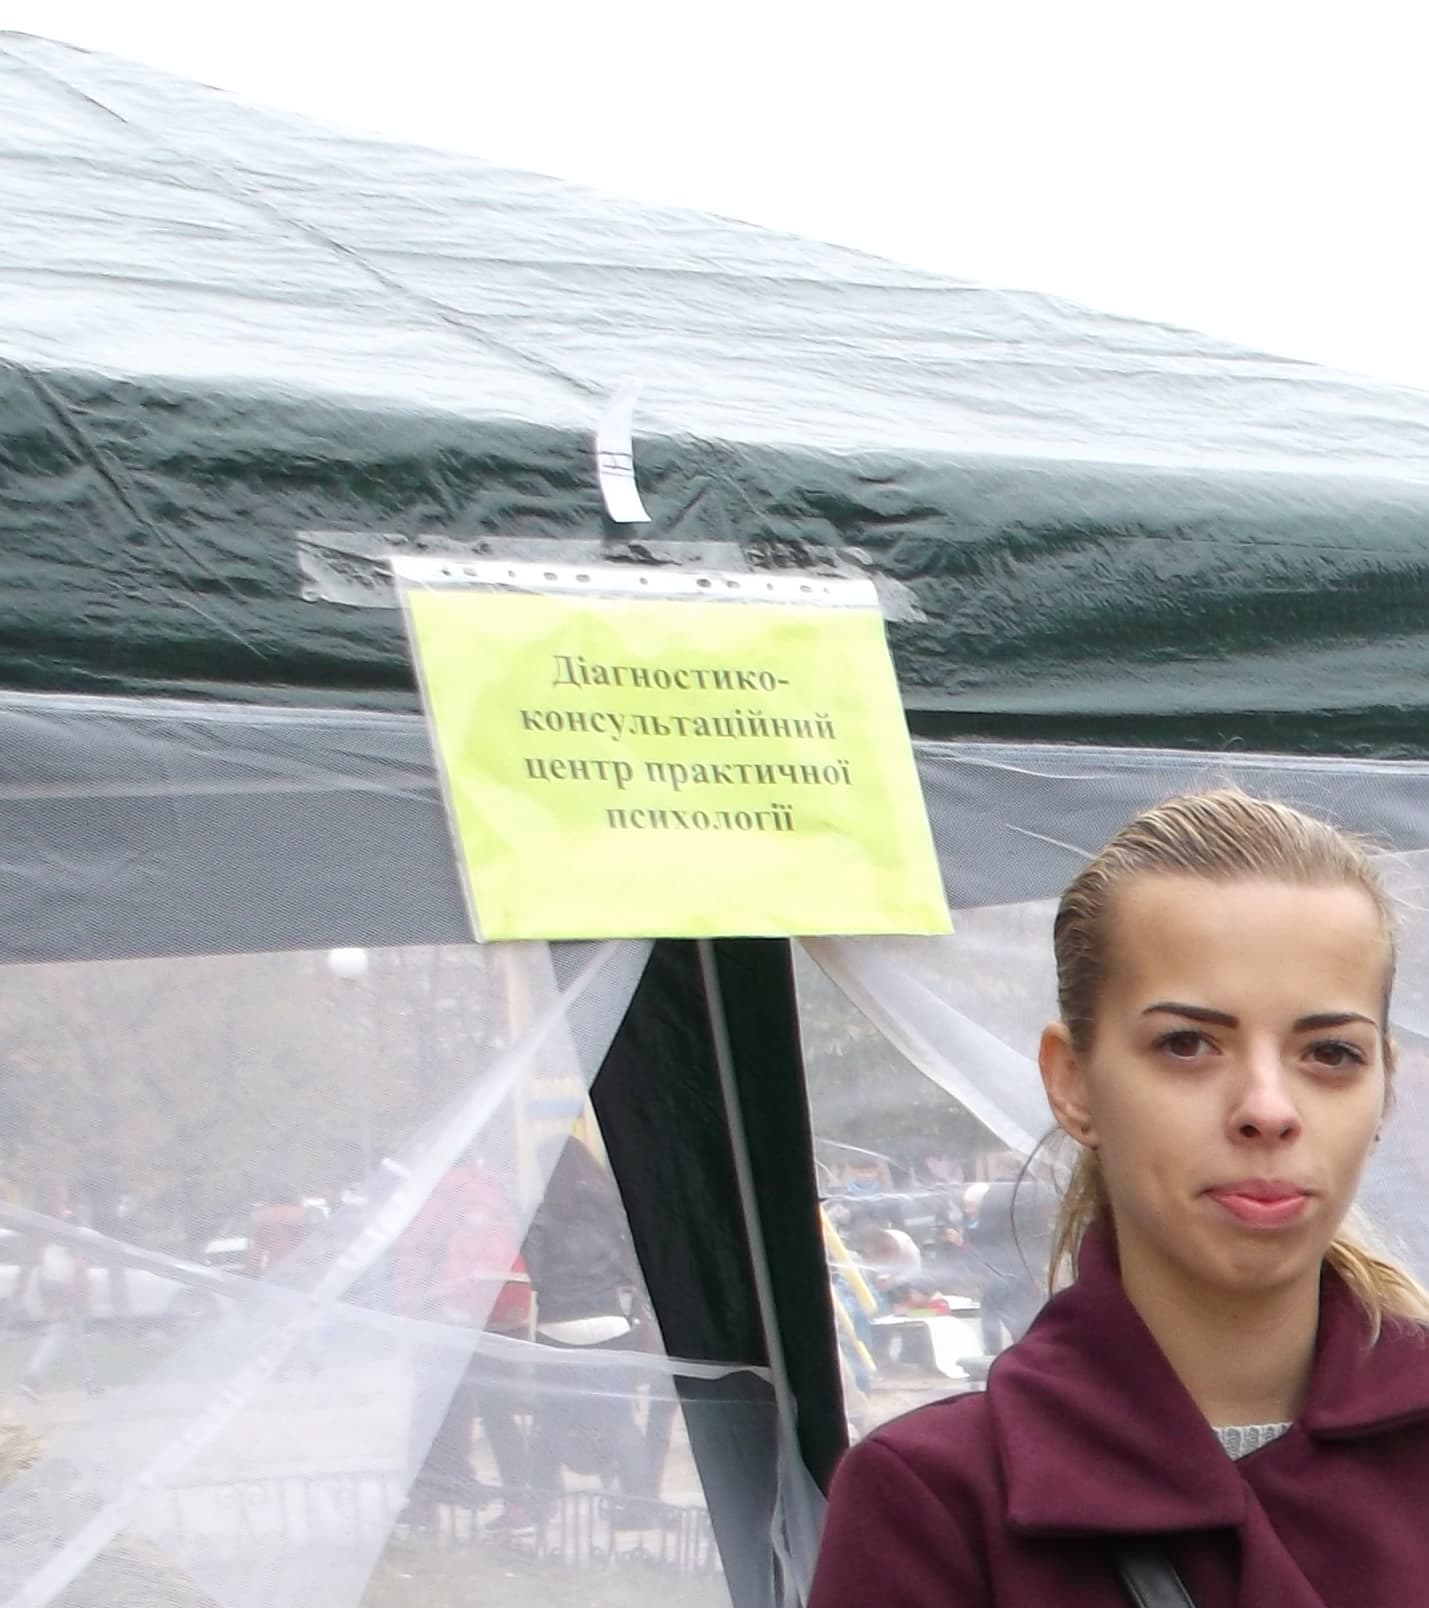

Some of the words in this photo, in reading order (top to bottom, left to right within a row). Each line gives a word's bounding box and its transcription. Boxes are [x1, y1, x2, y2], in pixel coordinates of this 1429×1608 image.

[552, 654, 791, 692] Діагностико-
[519, 708, 837, 742] консультаційний
[524, 757, 634, 790] центр
[644, 758, 855, 792] практичної
[606, 802, 796, 832] психології
